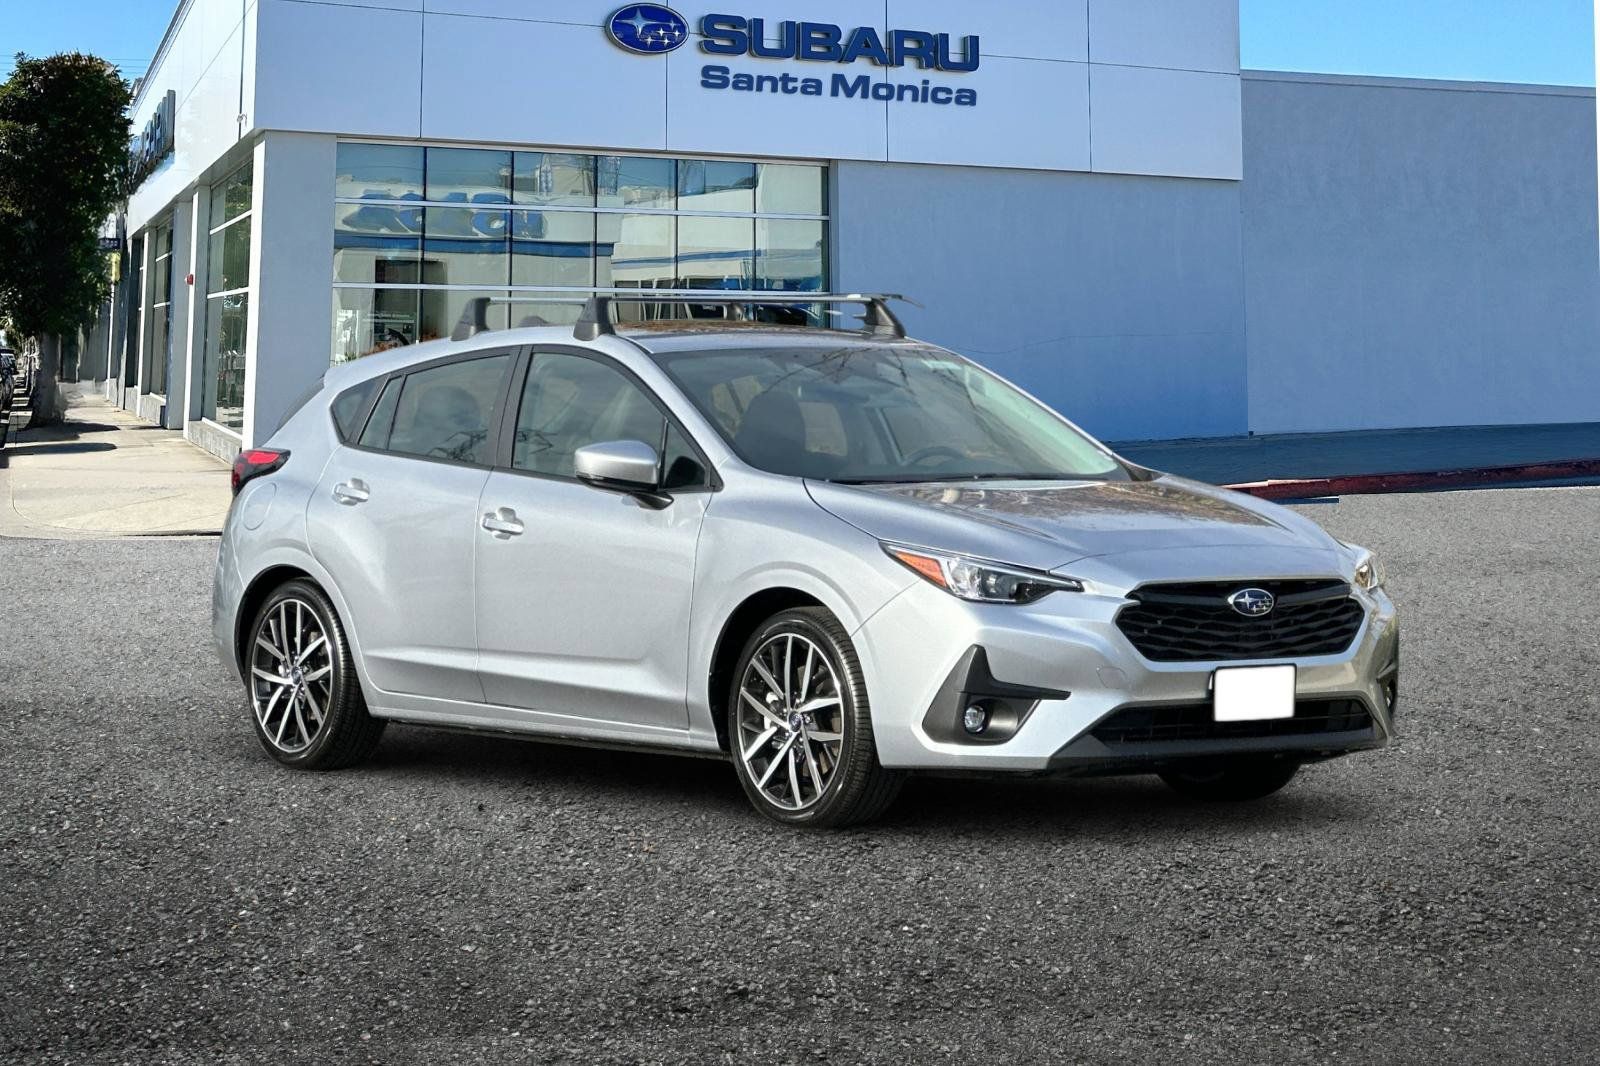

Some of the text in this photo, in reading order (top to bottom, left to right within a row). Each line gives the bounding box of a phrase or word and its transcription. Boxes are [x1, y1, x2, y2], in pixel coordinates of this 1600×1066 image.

[701, 13, 979, 72] SUBARU
[701, 64, 977, 106] Santa Monica
